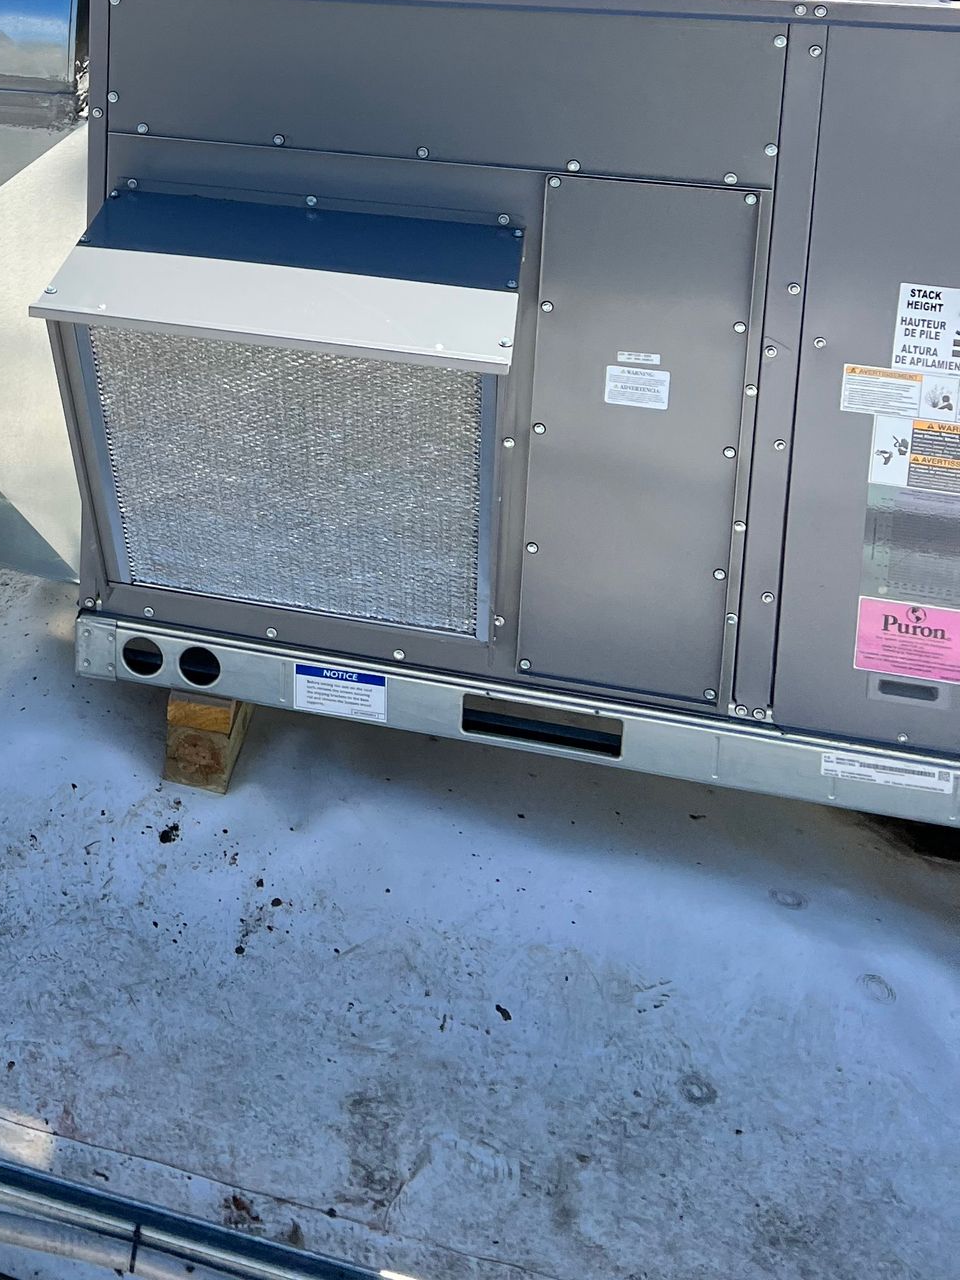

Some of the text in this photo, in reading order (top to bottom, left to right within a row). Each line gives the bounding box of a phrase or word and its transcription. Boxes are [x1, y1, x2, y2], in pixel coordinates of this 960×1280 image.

[910, 289, 942, 300] STACK
[907, 300, 944, 312] HEIGHT
[900, 316, 947, 330] HAUTEUR
[904, 328, 941, 340] DE PILE
[901, 344, 938, 357] ALTURA
[895, 355, 907, 364] DE
[937, 423, 960, 433] WAR
[323, 669, 358, 681] NOTICE
